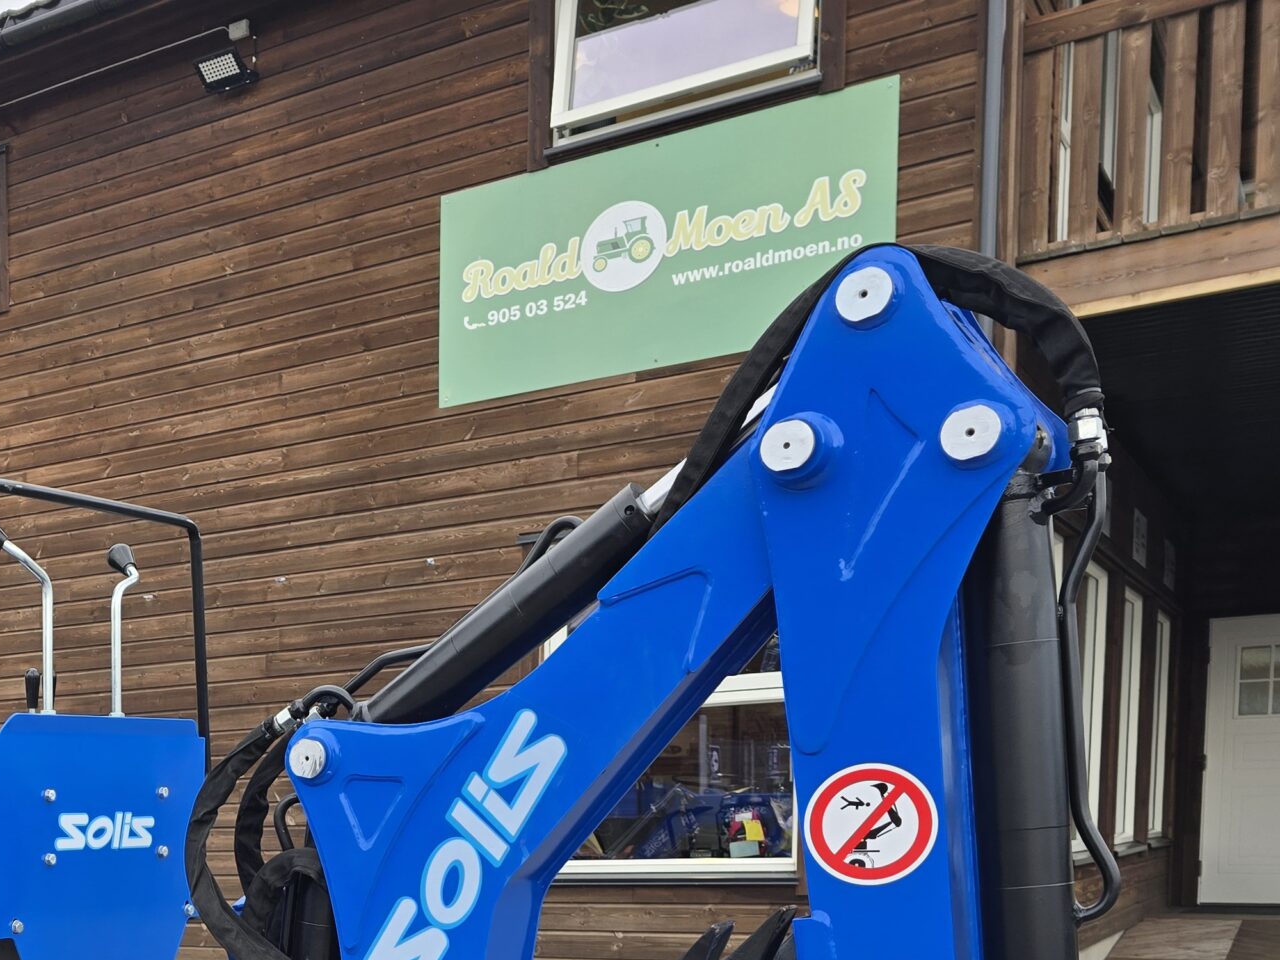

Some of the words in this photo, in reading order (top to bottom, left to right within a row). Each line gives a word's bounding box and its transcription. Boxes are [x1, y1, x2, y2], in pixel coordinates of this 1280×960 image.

[461, 236, 583, 303] Roald
[663, 203, 791, 257] Moen
[793, 168, 867, 228] AS
[671, 233, 863, 286] www.roaldmoen.no
[487, 305, 521, 326] 905
[525, 299, 548, 317] 03
[553, 290, 588, 312] 524
